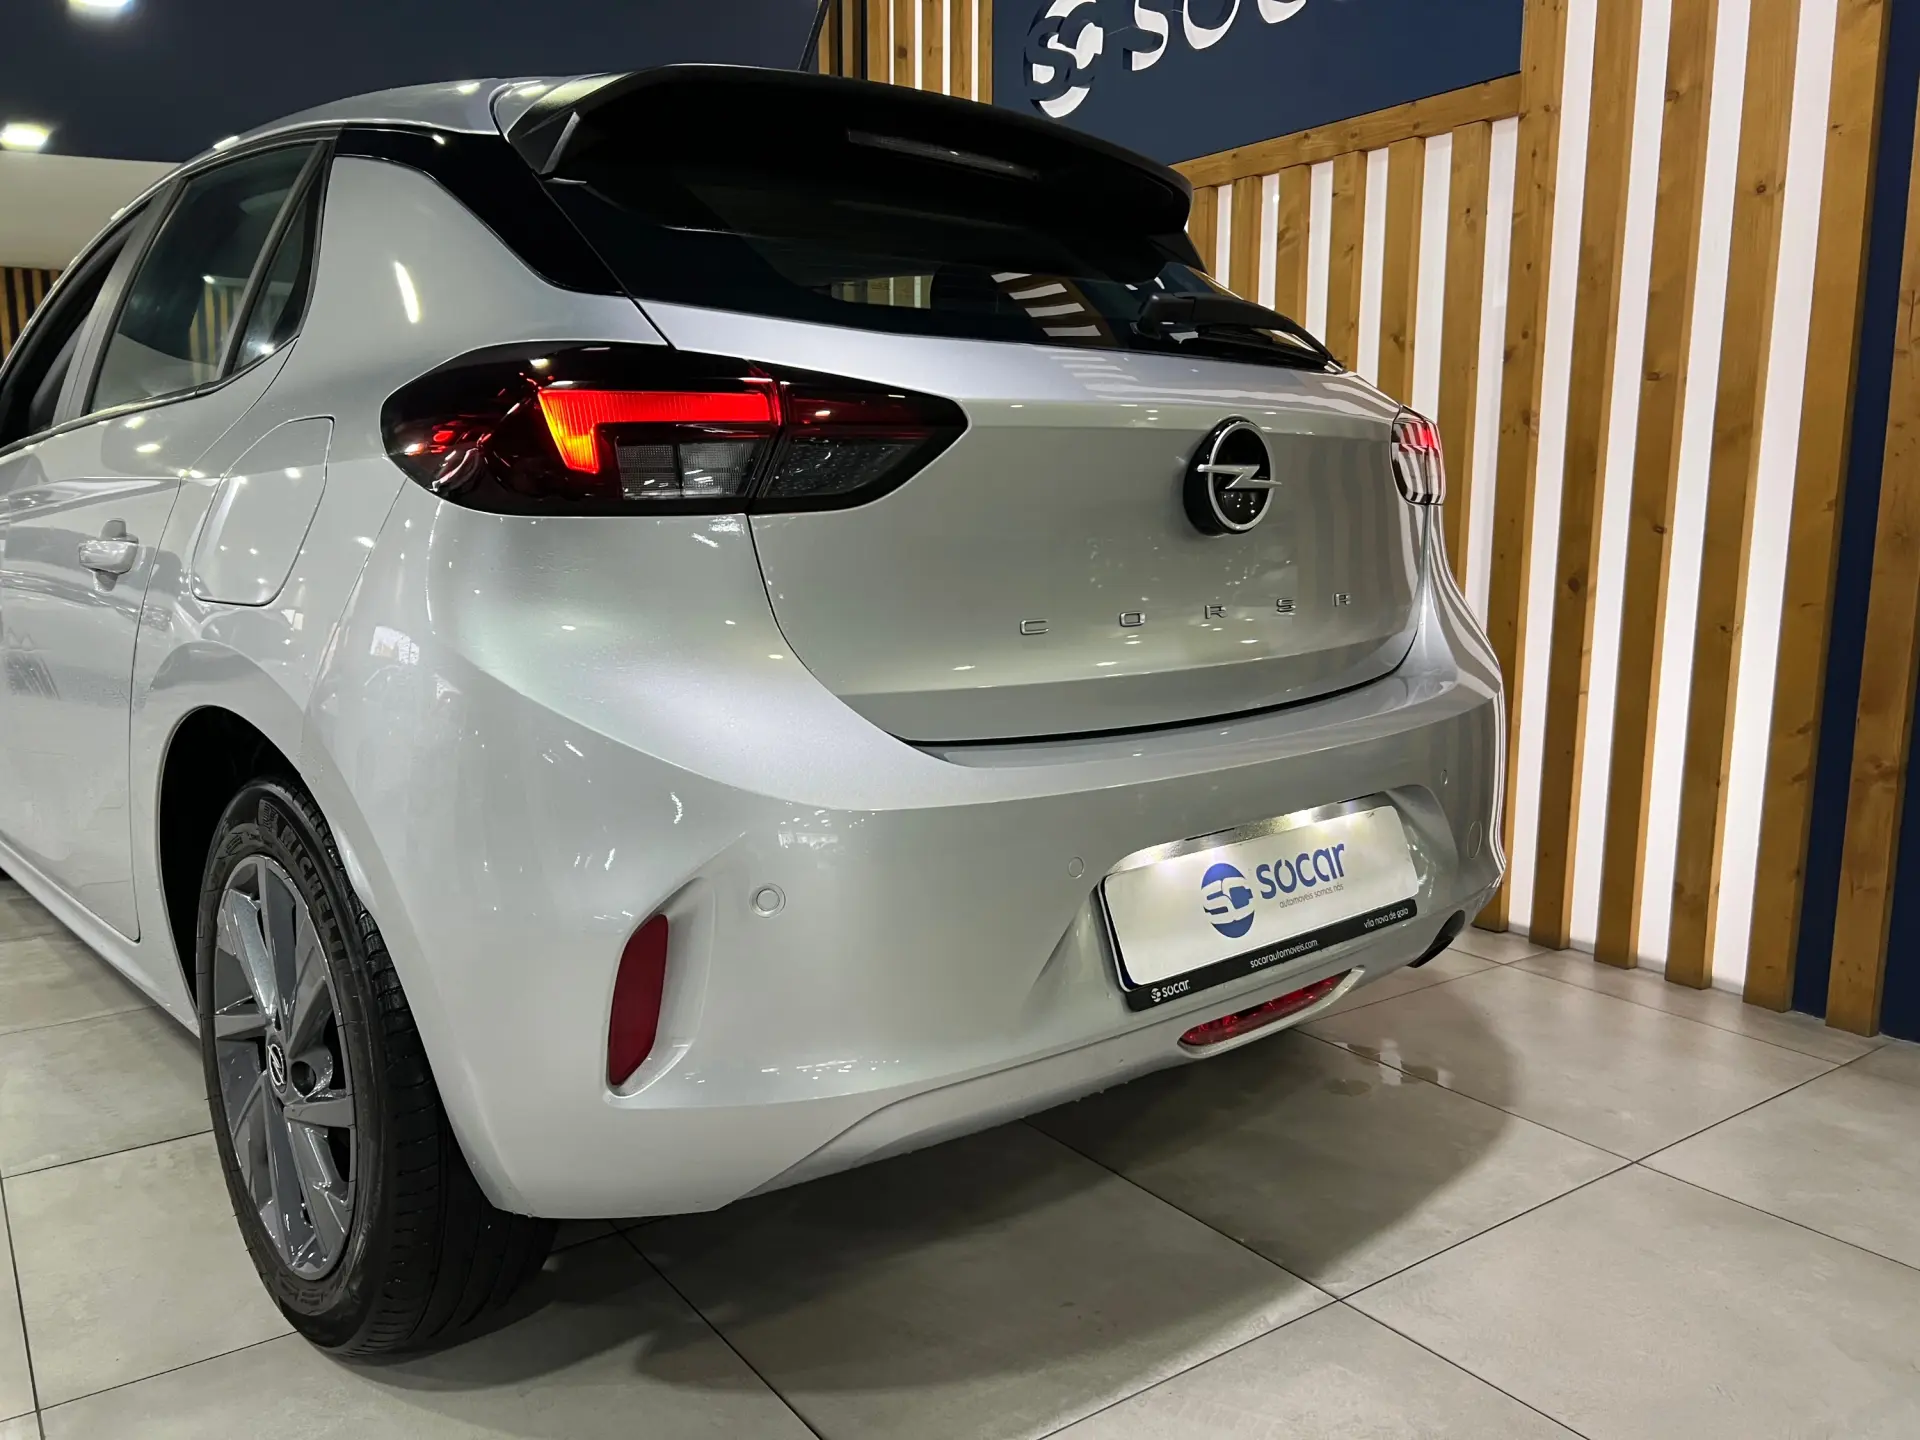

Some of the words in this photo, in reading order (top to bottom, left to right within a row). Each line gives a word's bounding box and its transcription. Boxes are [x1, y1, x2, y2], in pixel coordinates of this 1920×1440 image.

[1256, 843, 1345, 900] socar
[1389, 910, 1397, 921] de
[1250, 938, 1318, 968] socarautomoveis.com
[1162, 979, 1190, 998] socar
